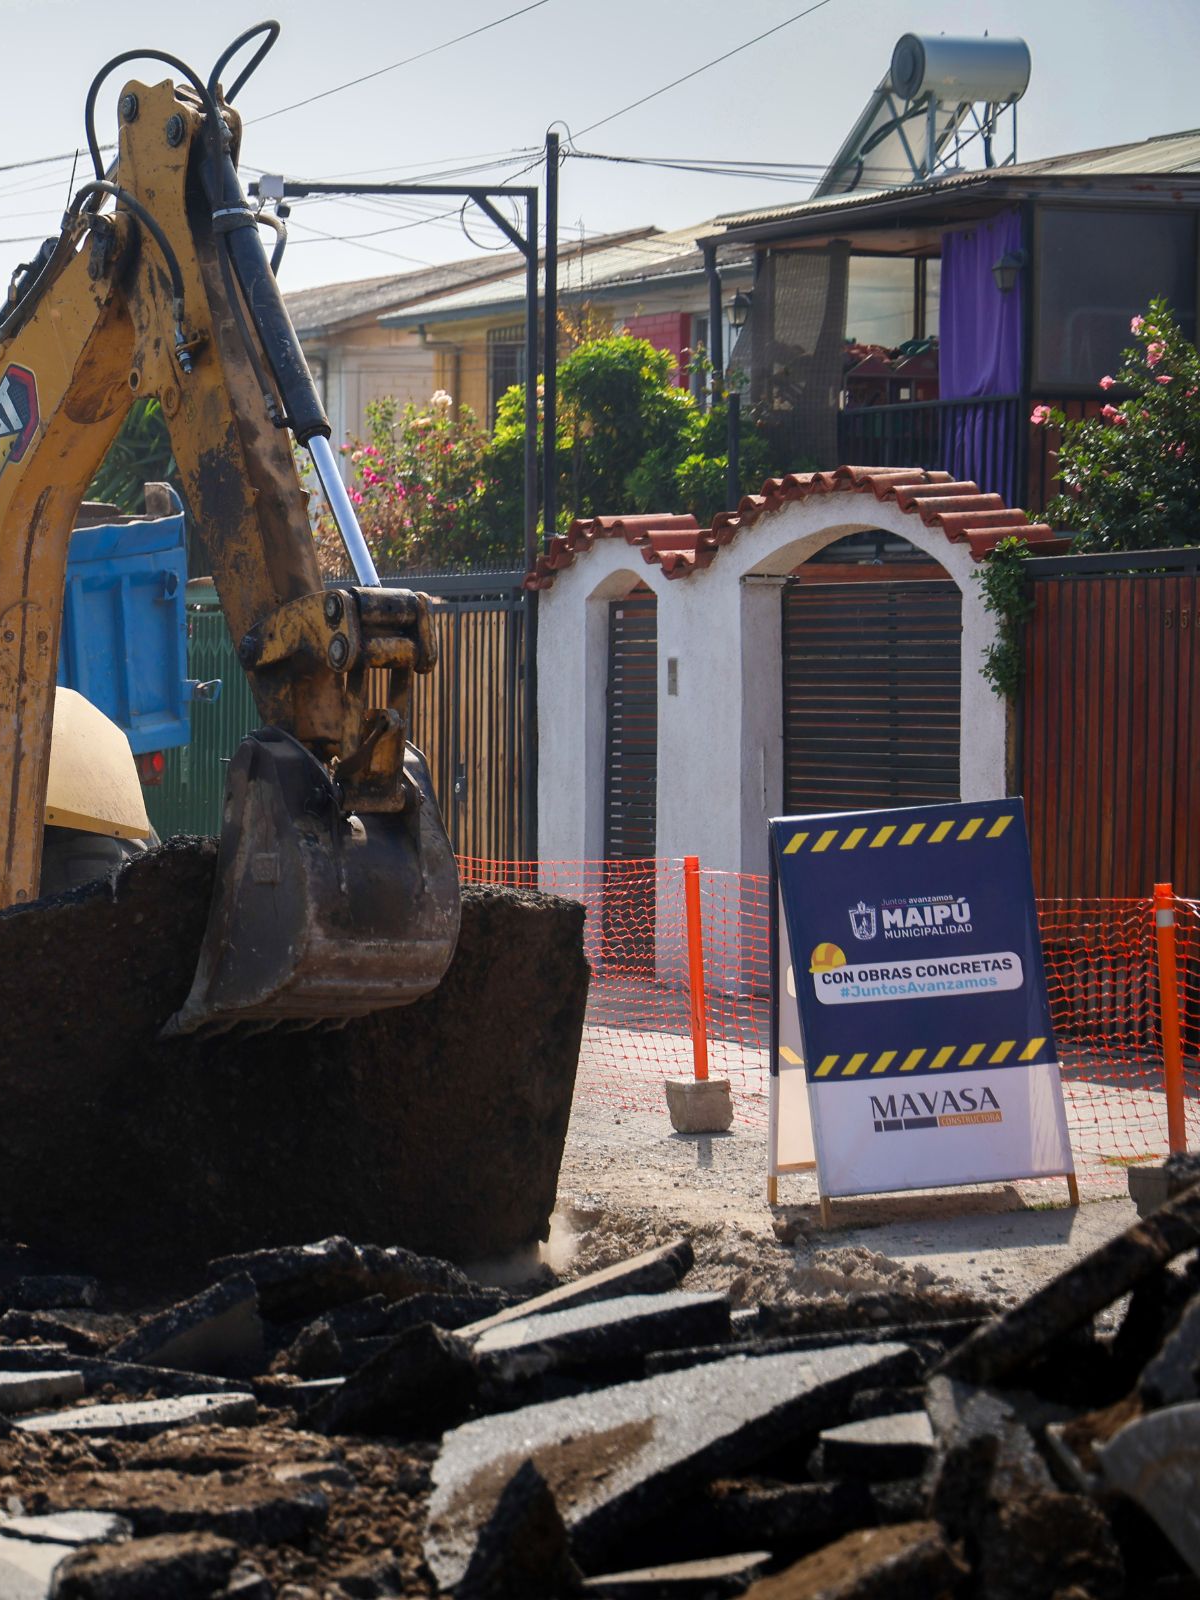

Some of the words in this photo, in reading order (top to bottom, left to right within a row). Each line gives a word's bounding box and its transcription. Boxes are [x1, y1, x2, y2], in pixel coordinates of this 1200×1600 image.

[881, 898, 907, 906] Juntos
[908, 894, 954, 904] avanzamos
[882, 897, 971, 929] MAIPÚ
[884, 923, 973, 940] MUNICIPALIDAD
[822, 968, 854, 984] CON
[858, 967, 912, 982] OBRAS
[916, 958, 1012, 978] CONCRETAS
[840, 976, 998, 999] #JuntosAvanzamos
[869, 1086, 1001, 1119] MAVASA
[940, 1113, 1001, 1127] CONSTRUCTORA
